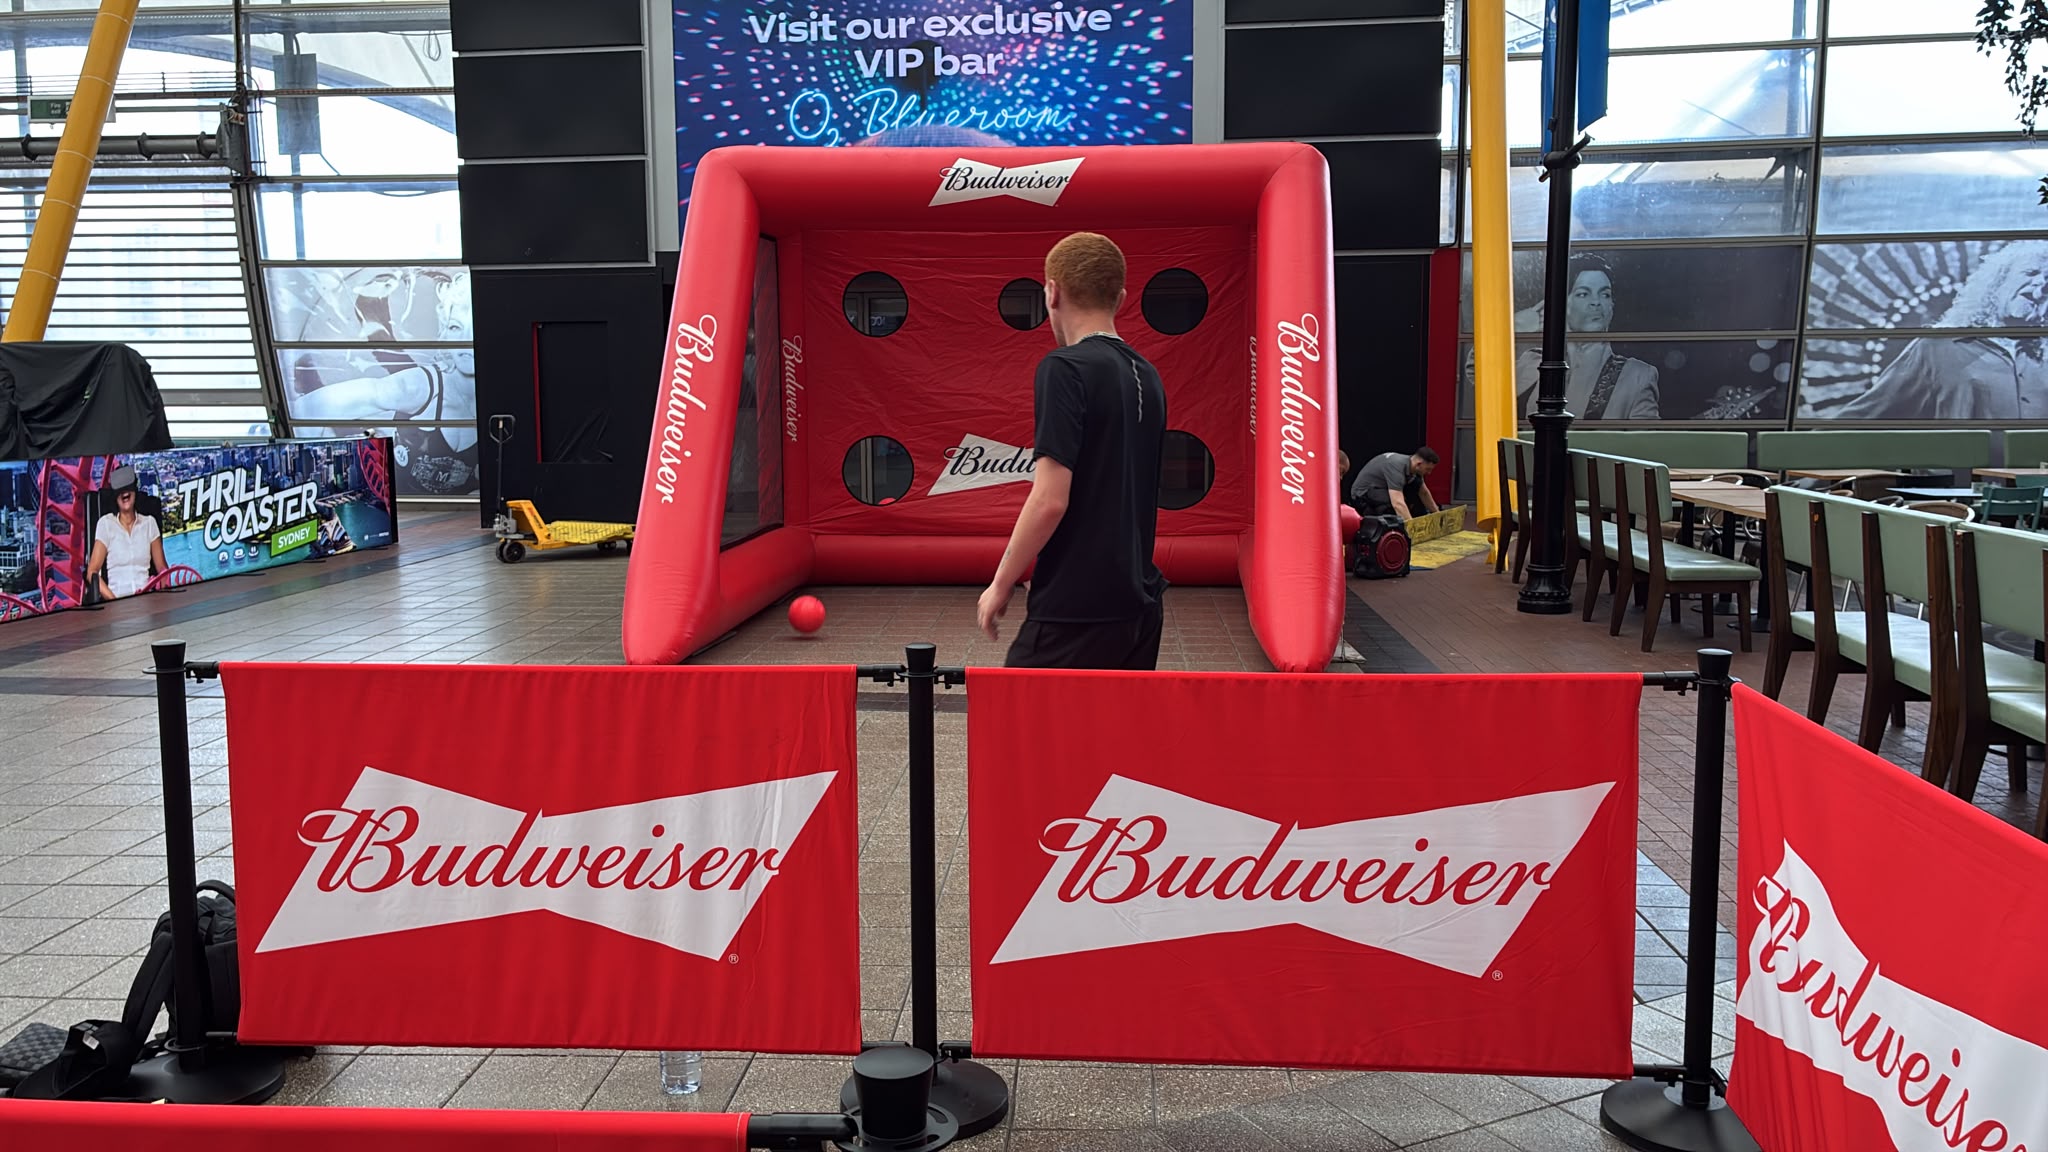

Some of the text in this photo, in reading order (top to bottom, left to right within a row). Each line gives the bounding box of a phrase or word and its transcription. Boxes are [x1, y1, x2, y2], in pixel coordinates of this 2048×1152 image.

[748, 2, 1112, 43] Visit our exclusive
[854, 46, 1004, 78] VIP bar
[939, 166, 1069, 191] Budweiser
[656, 314, 717, 504] Budweiser
[782, 335, 804, 443] Budweiser
[1277, 313, 1321, 505] Budweiser
[179, 464, 269, 521] THRILL
[204, 481, 318, 550] COASTER
[278, 526, 311, 549] SYDNEY
[297, 805, 781, 893] Budweiser
[1038, 815, 1553, 906] Budweiser
[1752, 874, 2028, 1152] Budweise
